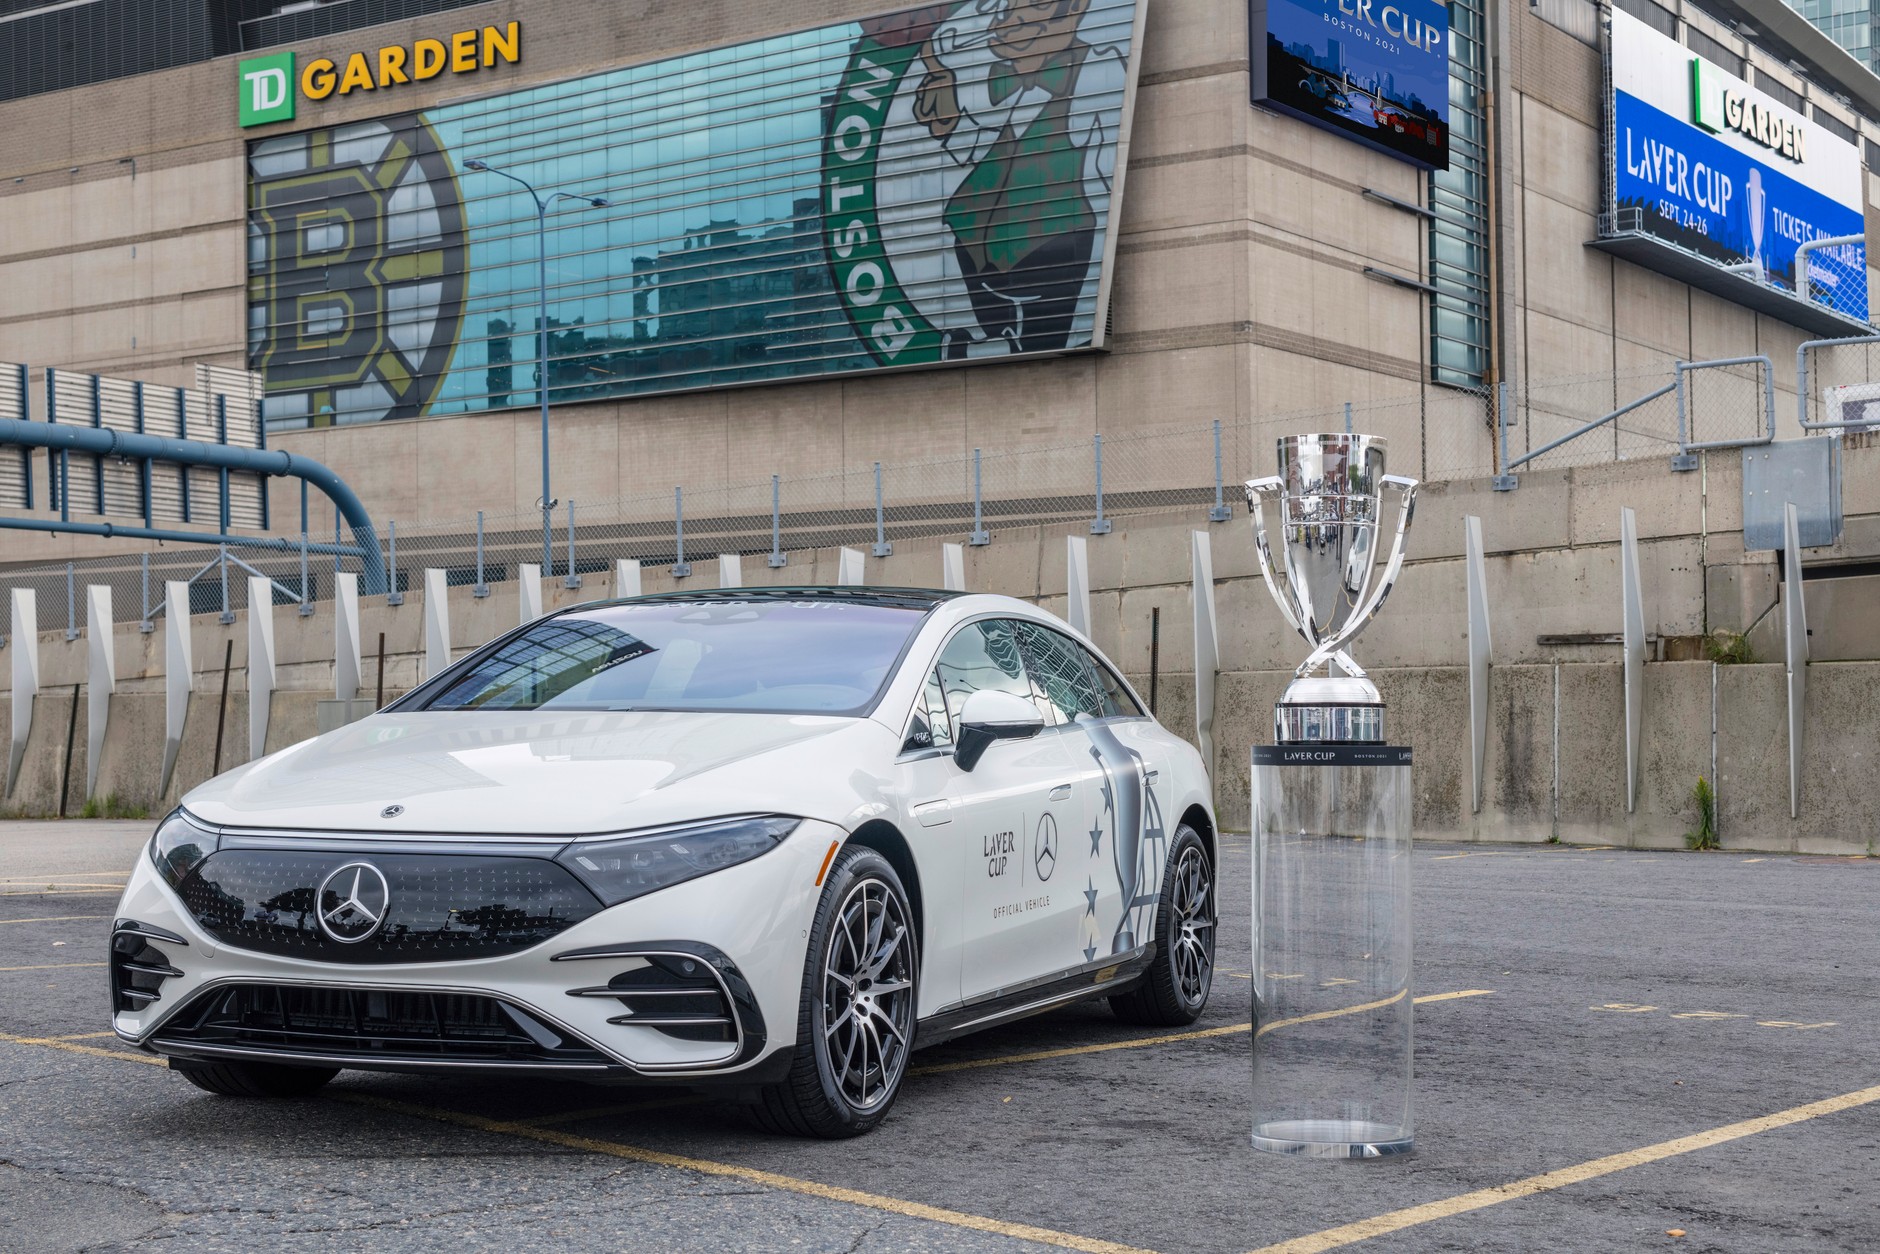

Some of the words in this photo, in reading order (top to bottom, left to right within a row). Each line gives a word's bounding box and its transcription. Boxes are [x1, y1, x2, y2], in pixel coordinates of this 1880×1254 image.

[1323, 12, 1371, 41] BOSTON
[1375, 37, 1400, 55] 2021
[1381, 5, 1441, 54] CUP
[244, 67, 287, 112] TD
[301, 21, 520, 100] GARDEN
[1724, 87, 1806, 164] GARDEN
[1626, 126, 1692, 202] LAVER
[1693, 161, 1733, 218] CUP
[830, 57, 917, 361] BOSTON
[1659, 198, 1682, 225] SEPT.
[1683, 208, 1708, 236] 24-26
[1772, 206, 1813, 246] TICKETS
[1284, 752, 1313, 760] LAVER
[1314, 752, 1336, 760] CUP
[983, 831, 1015, 857] LAVER
[988, 856, 1008, 878] CUP
[993, 902, 1023, 919] OFFICIAL
[1024, 895, 1050, 911] VEHICLE
